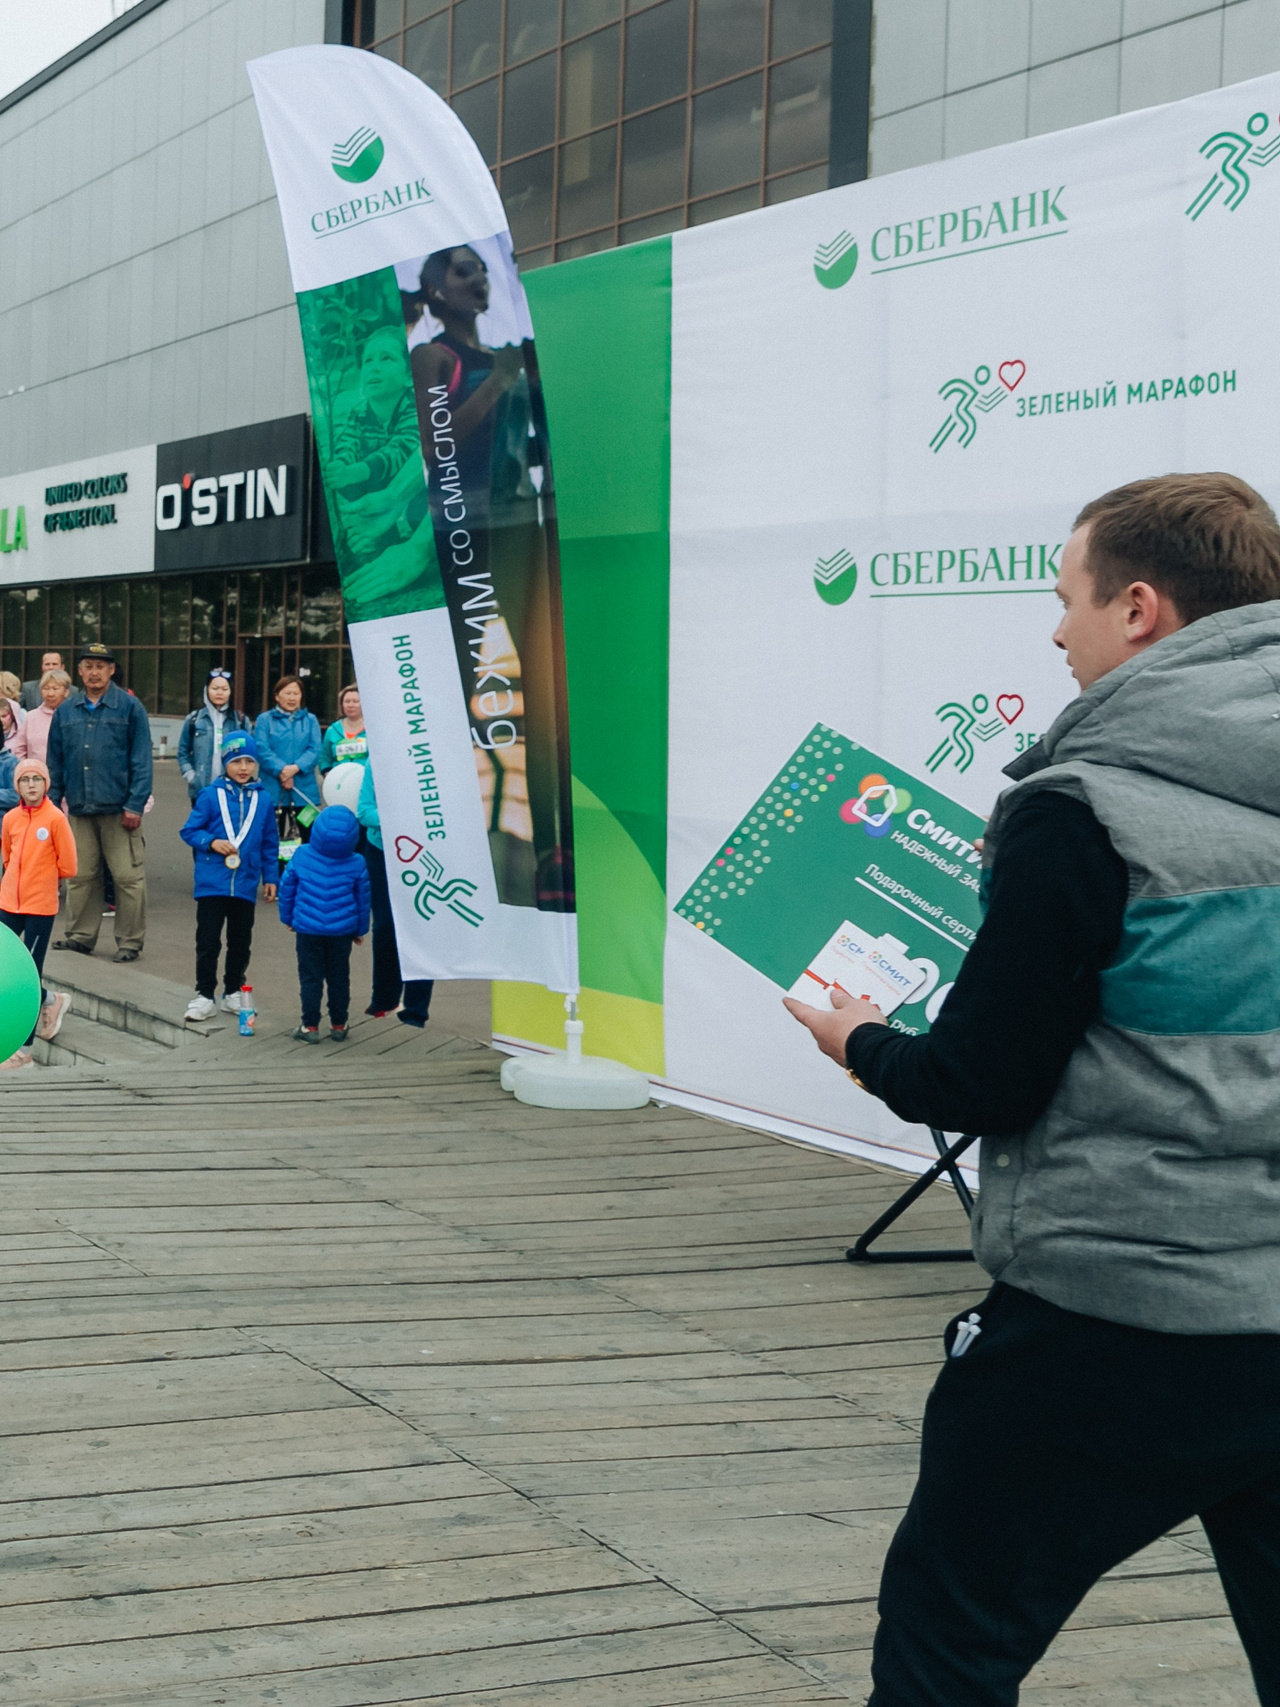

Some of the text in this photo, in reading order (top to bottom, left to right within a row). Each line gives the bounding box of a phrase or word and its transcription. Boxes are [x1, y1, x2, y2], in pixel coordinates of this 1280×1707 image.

[310, 177, 432, 233] СБЕРБАНК
[870, 185, 1068, 262] СБЕРБАНК
[1016, 369, 1237, 418] ЗЕЛЕНЫЙ МАРАФОН
[45, 472, 127, 506] UNITED COLORS
[156, 464, 288, 531] O'STIN
[869, 543, 1062, 587] СБЕРБАНК
[392, 634, 446, 841] ЗЕЛЕНЫЙ МАРАФОН
[1015, 733, 1036, 752] ЗЕ
[890, 830, 980, 893] НАДЕЖНЫЙ ЗАС
[865, 863, 977, 941] Подарочный серти
[879, 960, 912, 987] СМИТ
